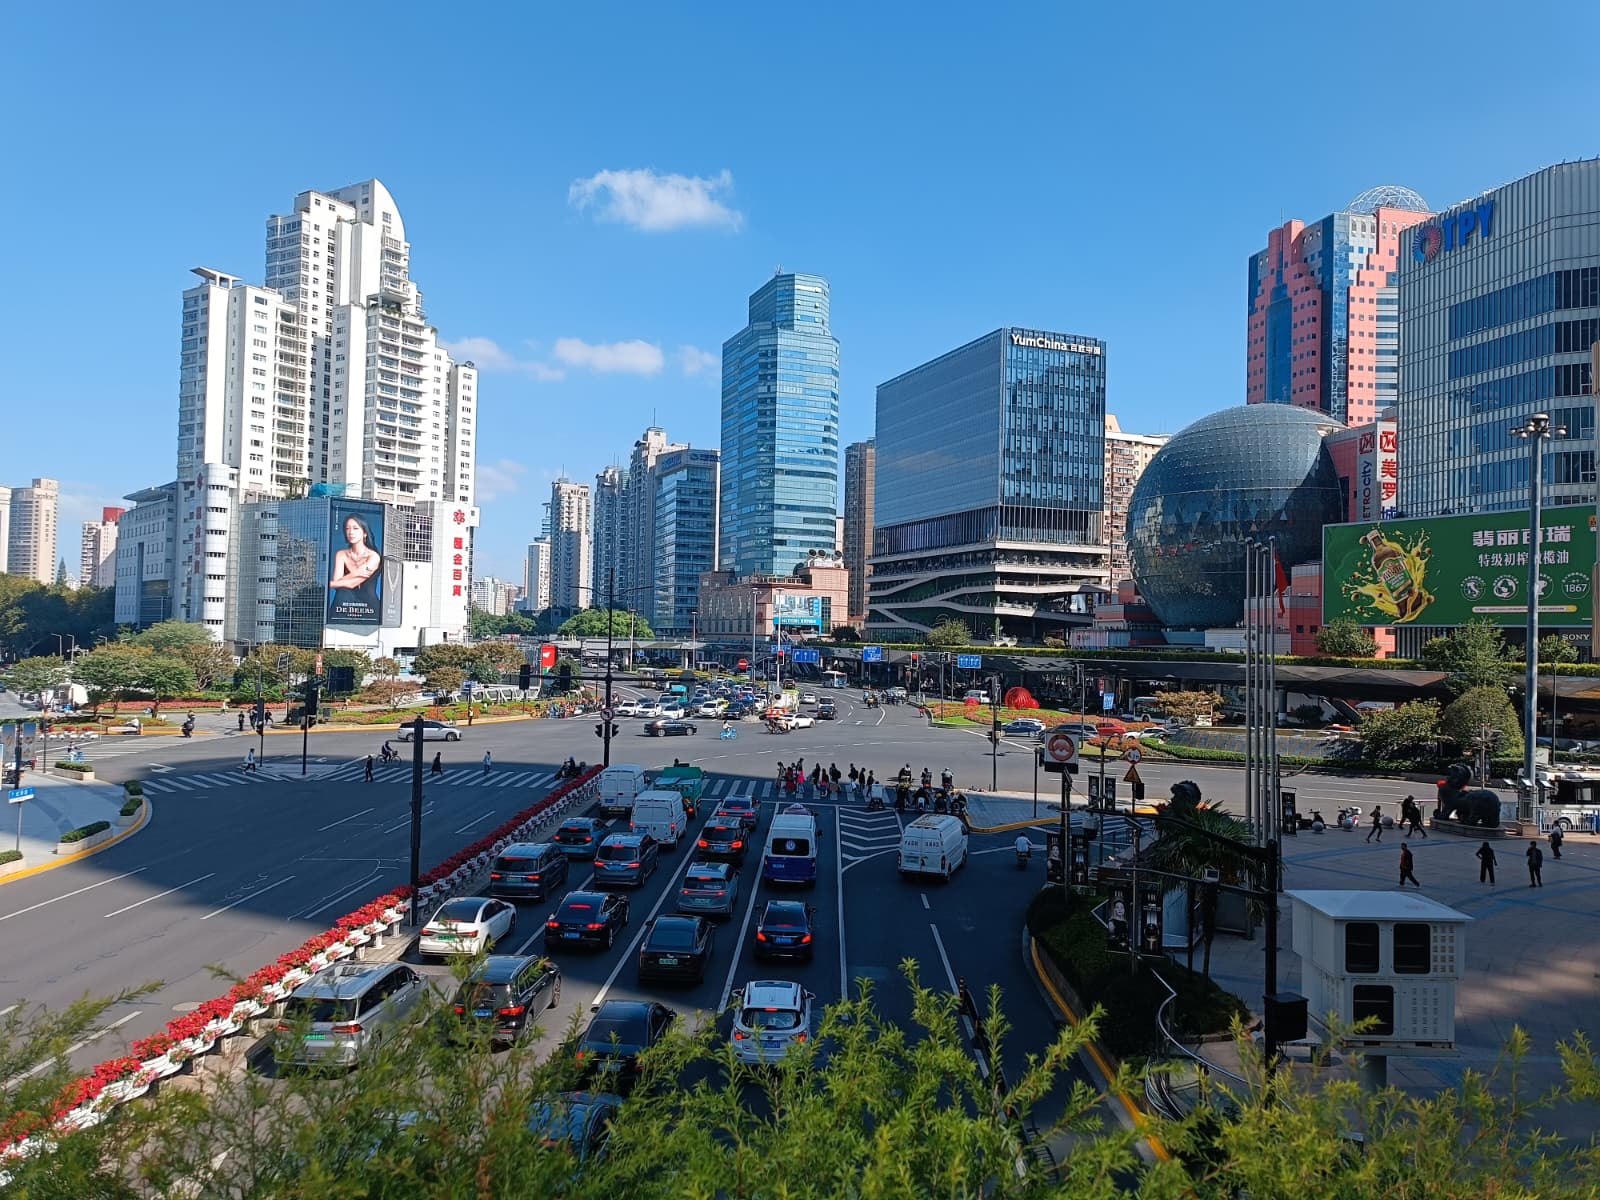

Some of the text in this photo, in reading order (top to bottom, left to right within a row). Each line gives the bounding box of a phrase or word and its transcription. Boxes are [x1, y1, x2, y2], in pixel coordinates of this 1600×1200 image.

[1442, 199, 1495, 252] TPY
[1011, 333, 1067, 351] YumChina
[1381, 458, 1397, 520] 美罗城
[1478, 549, 1569, 568] 特级初榨榄油
[1564, 583, 1588, 593] 1867
[1561, 633, 1590, 641] SONY
